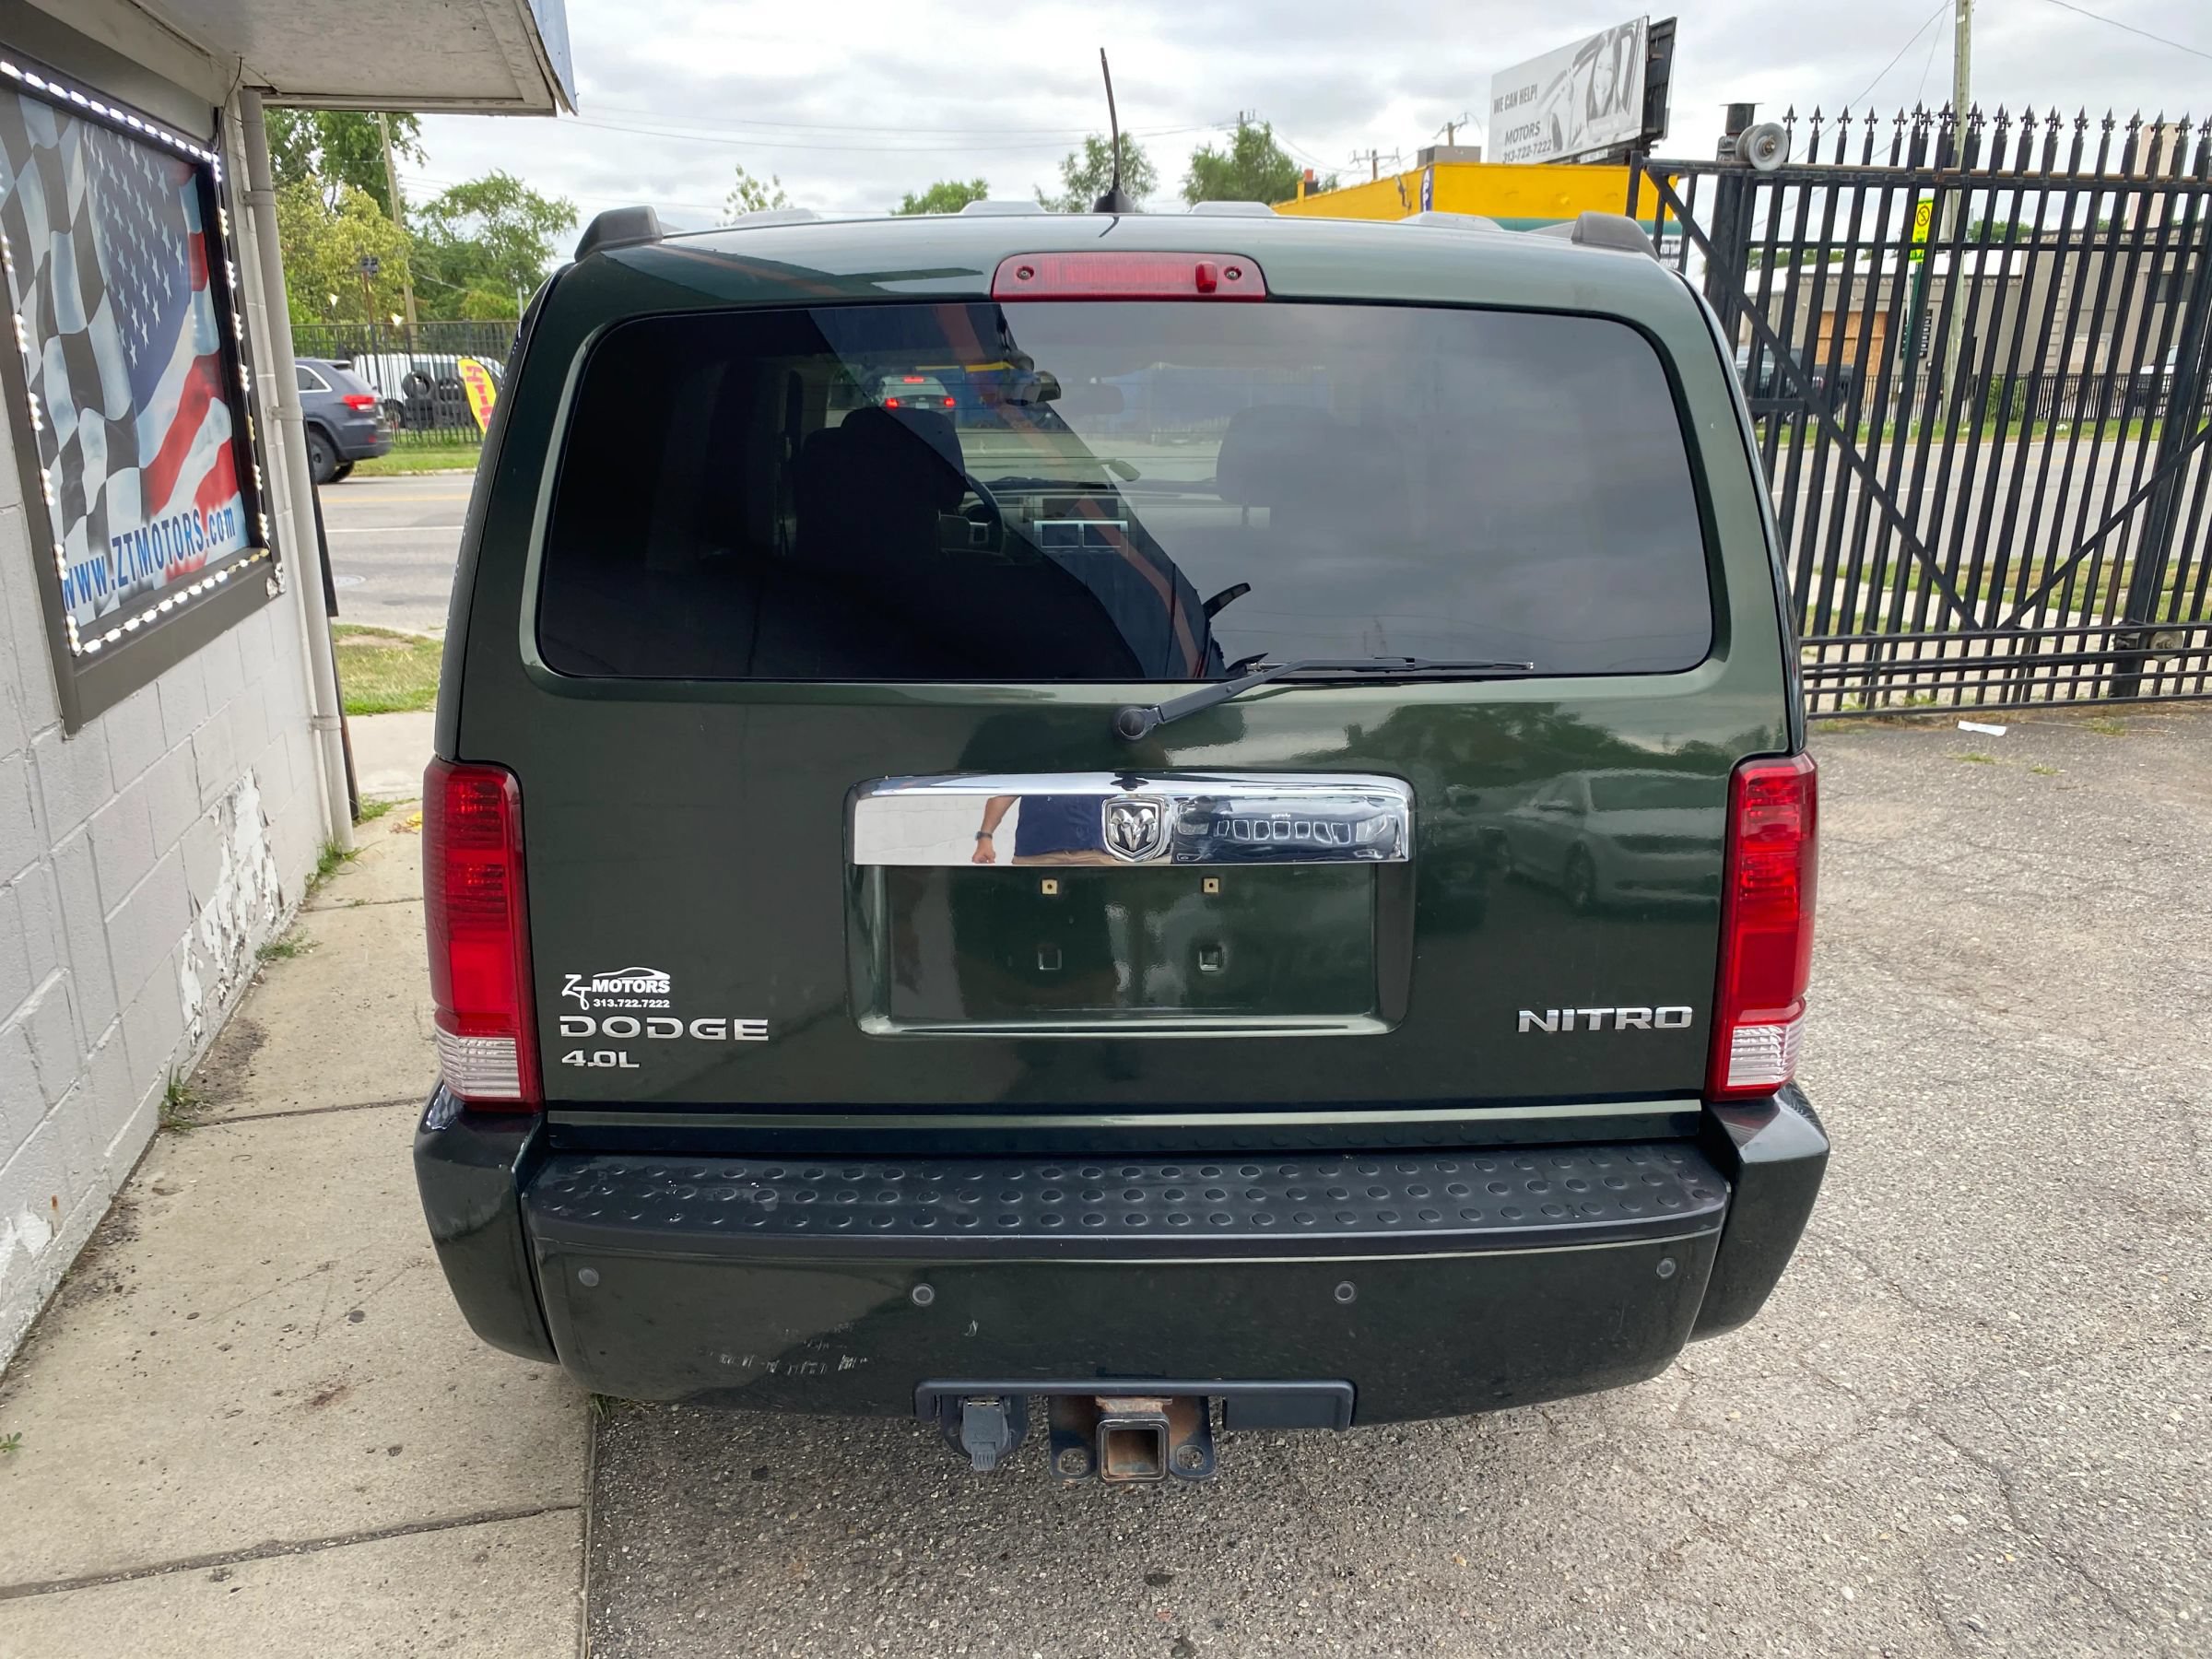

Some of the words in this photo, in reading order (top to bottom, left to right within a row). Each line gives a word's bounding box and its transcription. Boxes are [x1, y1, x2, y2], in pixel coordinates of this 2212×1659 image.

[1493, 96, 1504, 114] WE
[1504, 90, 1518, 111] CAN
[1518, 83, 1537, 105] HELP!
[1504, 121, 1540, 146] MOTORS
[1502, 139, 1552, 164] 313-722-7222
[592, 979, 671, 994] MOTORS
[593, 998, 671, 1008] 313.722.7222
[559, 1015, 769, 1041] DODGE
[1518, 1006, 1693, 1033] NITRO
[561, 1050, 641, 1068] 4.0L
